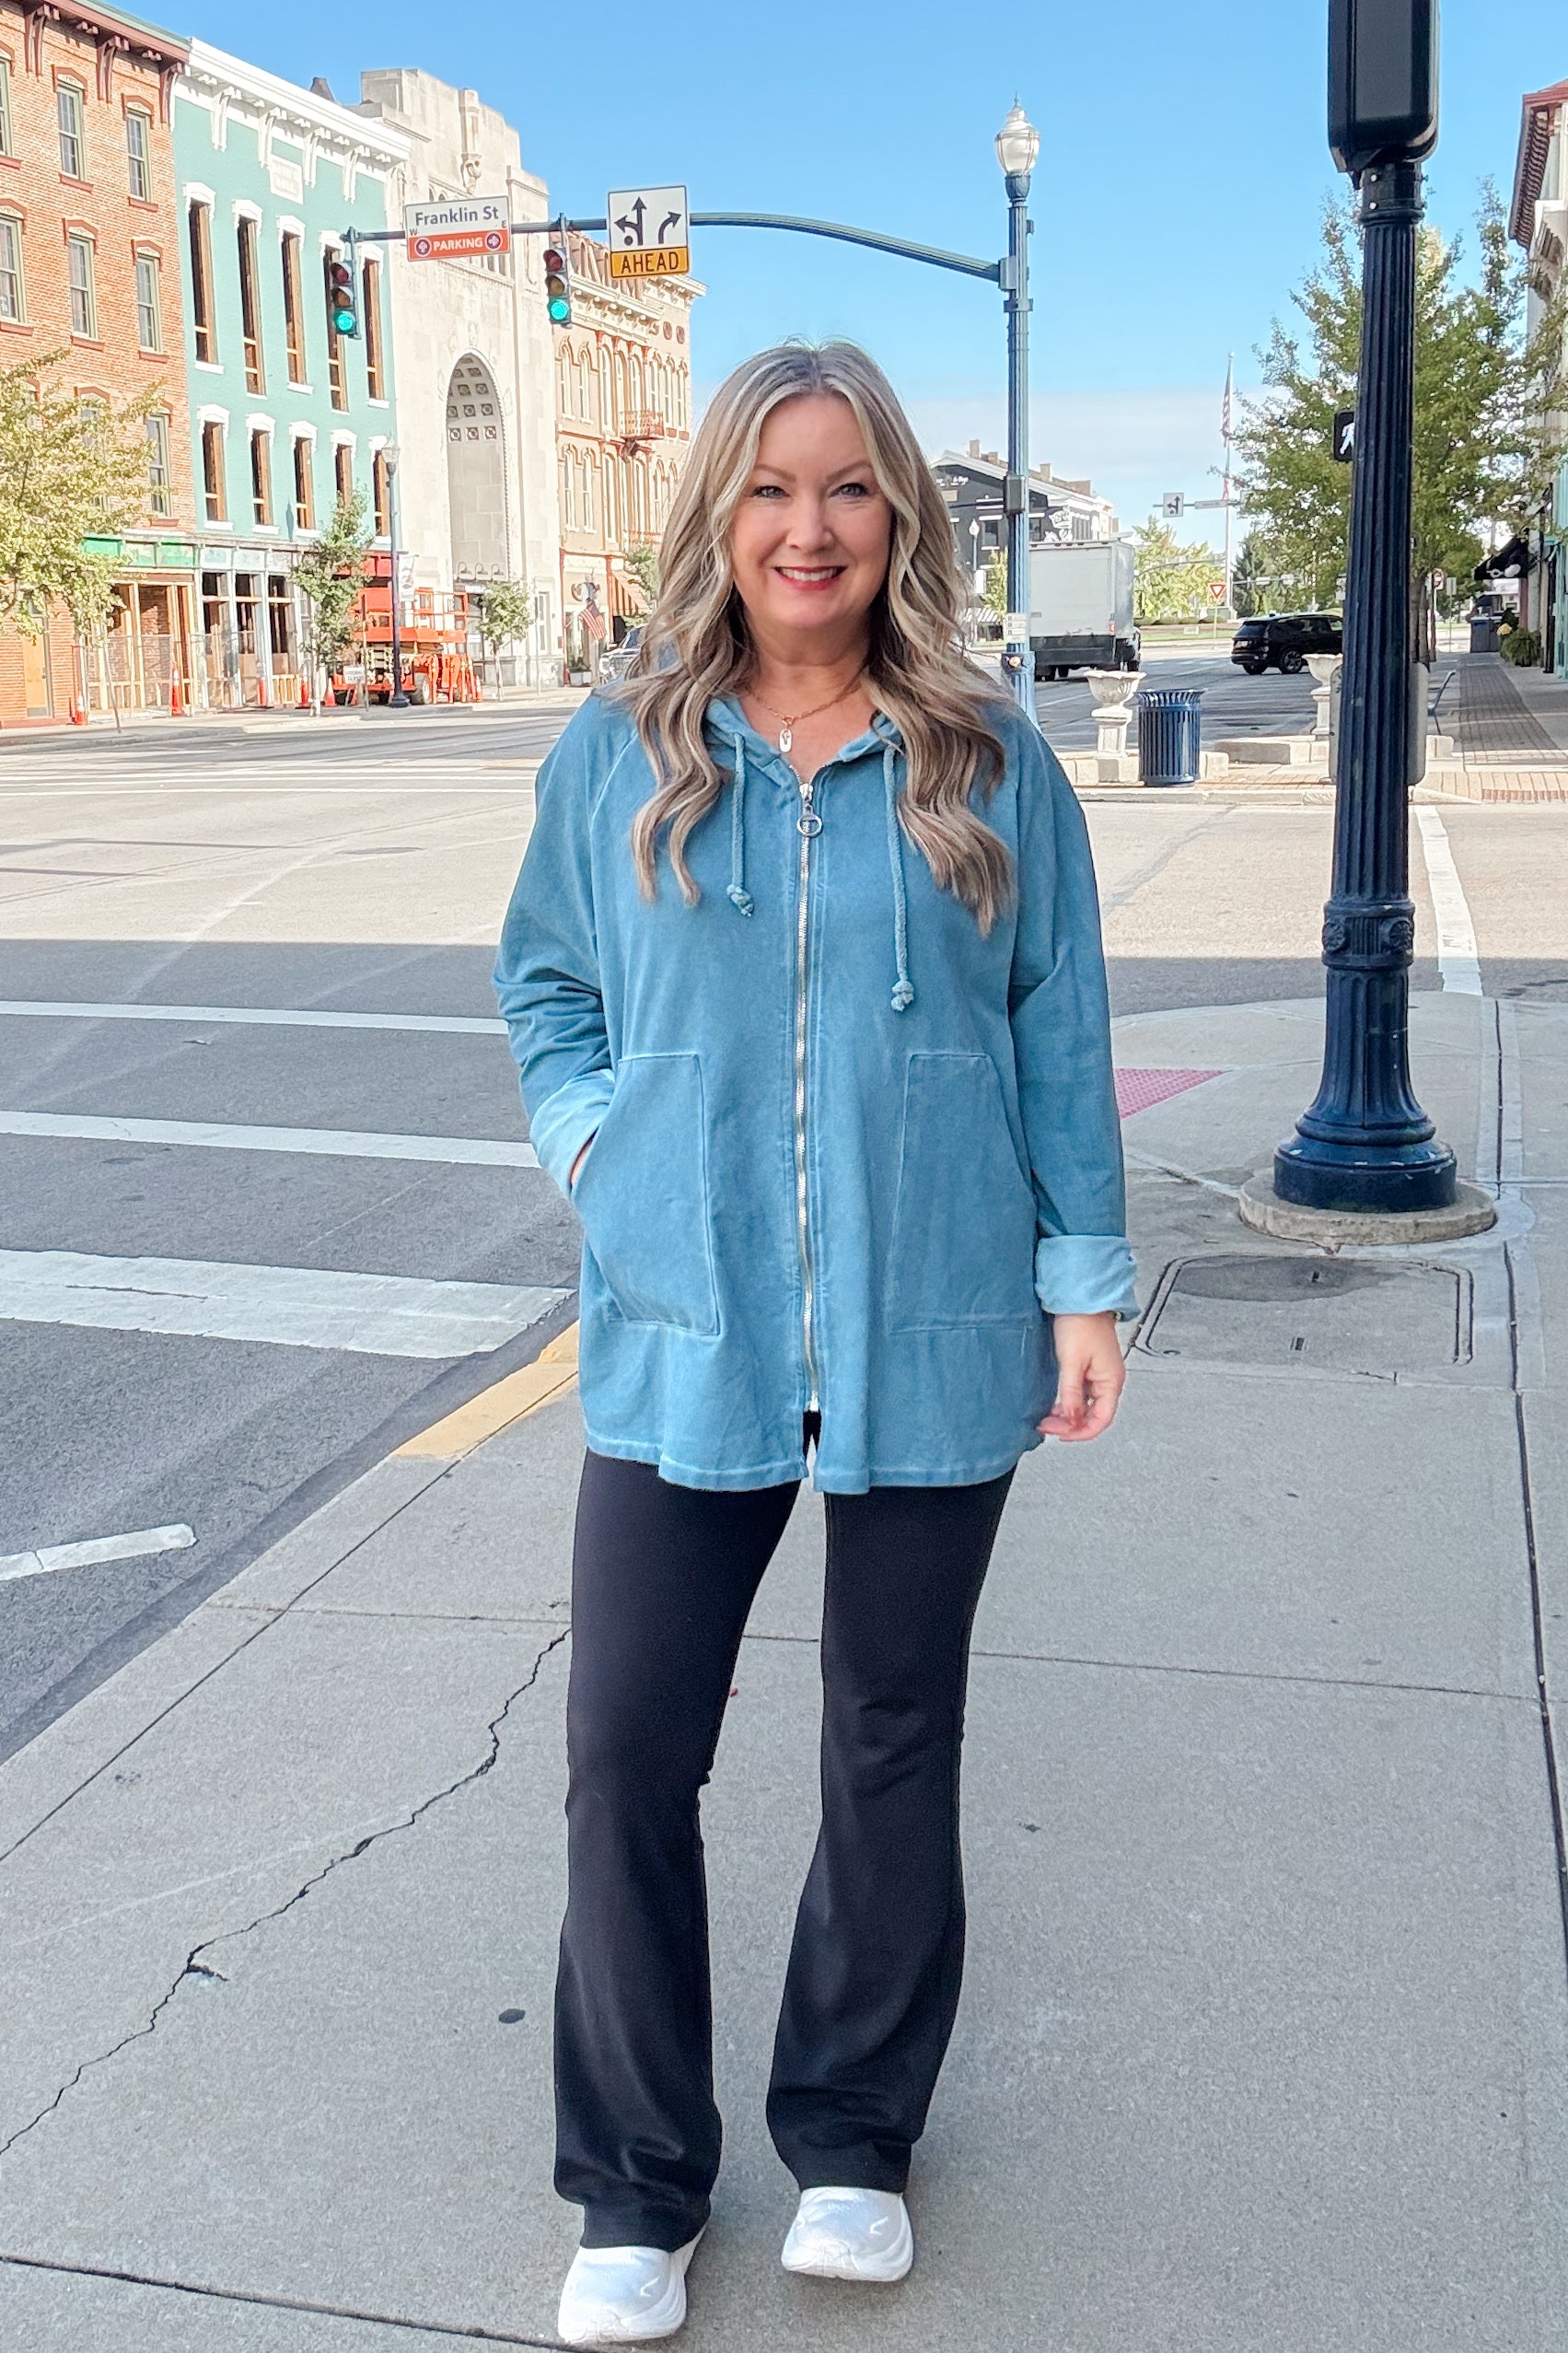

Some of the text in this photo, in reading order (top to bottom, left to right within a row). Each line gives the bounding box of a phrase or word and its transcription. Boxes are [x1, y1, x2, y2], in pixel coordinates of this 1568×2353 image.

[415, 205, 499, 226] Franklin St
[433, 237, 483, 251] PARKING
[621, 251, 679, 274] AHEAD
